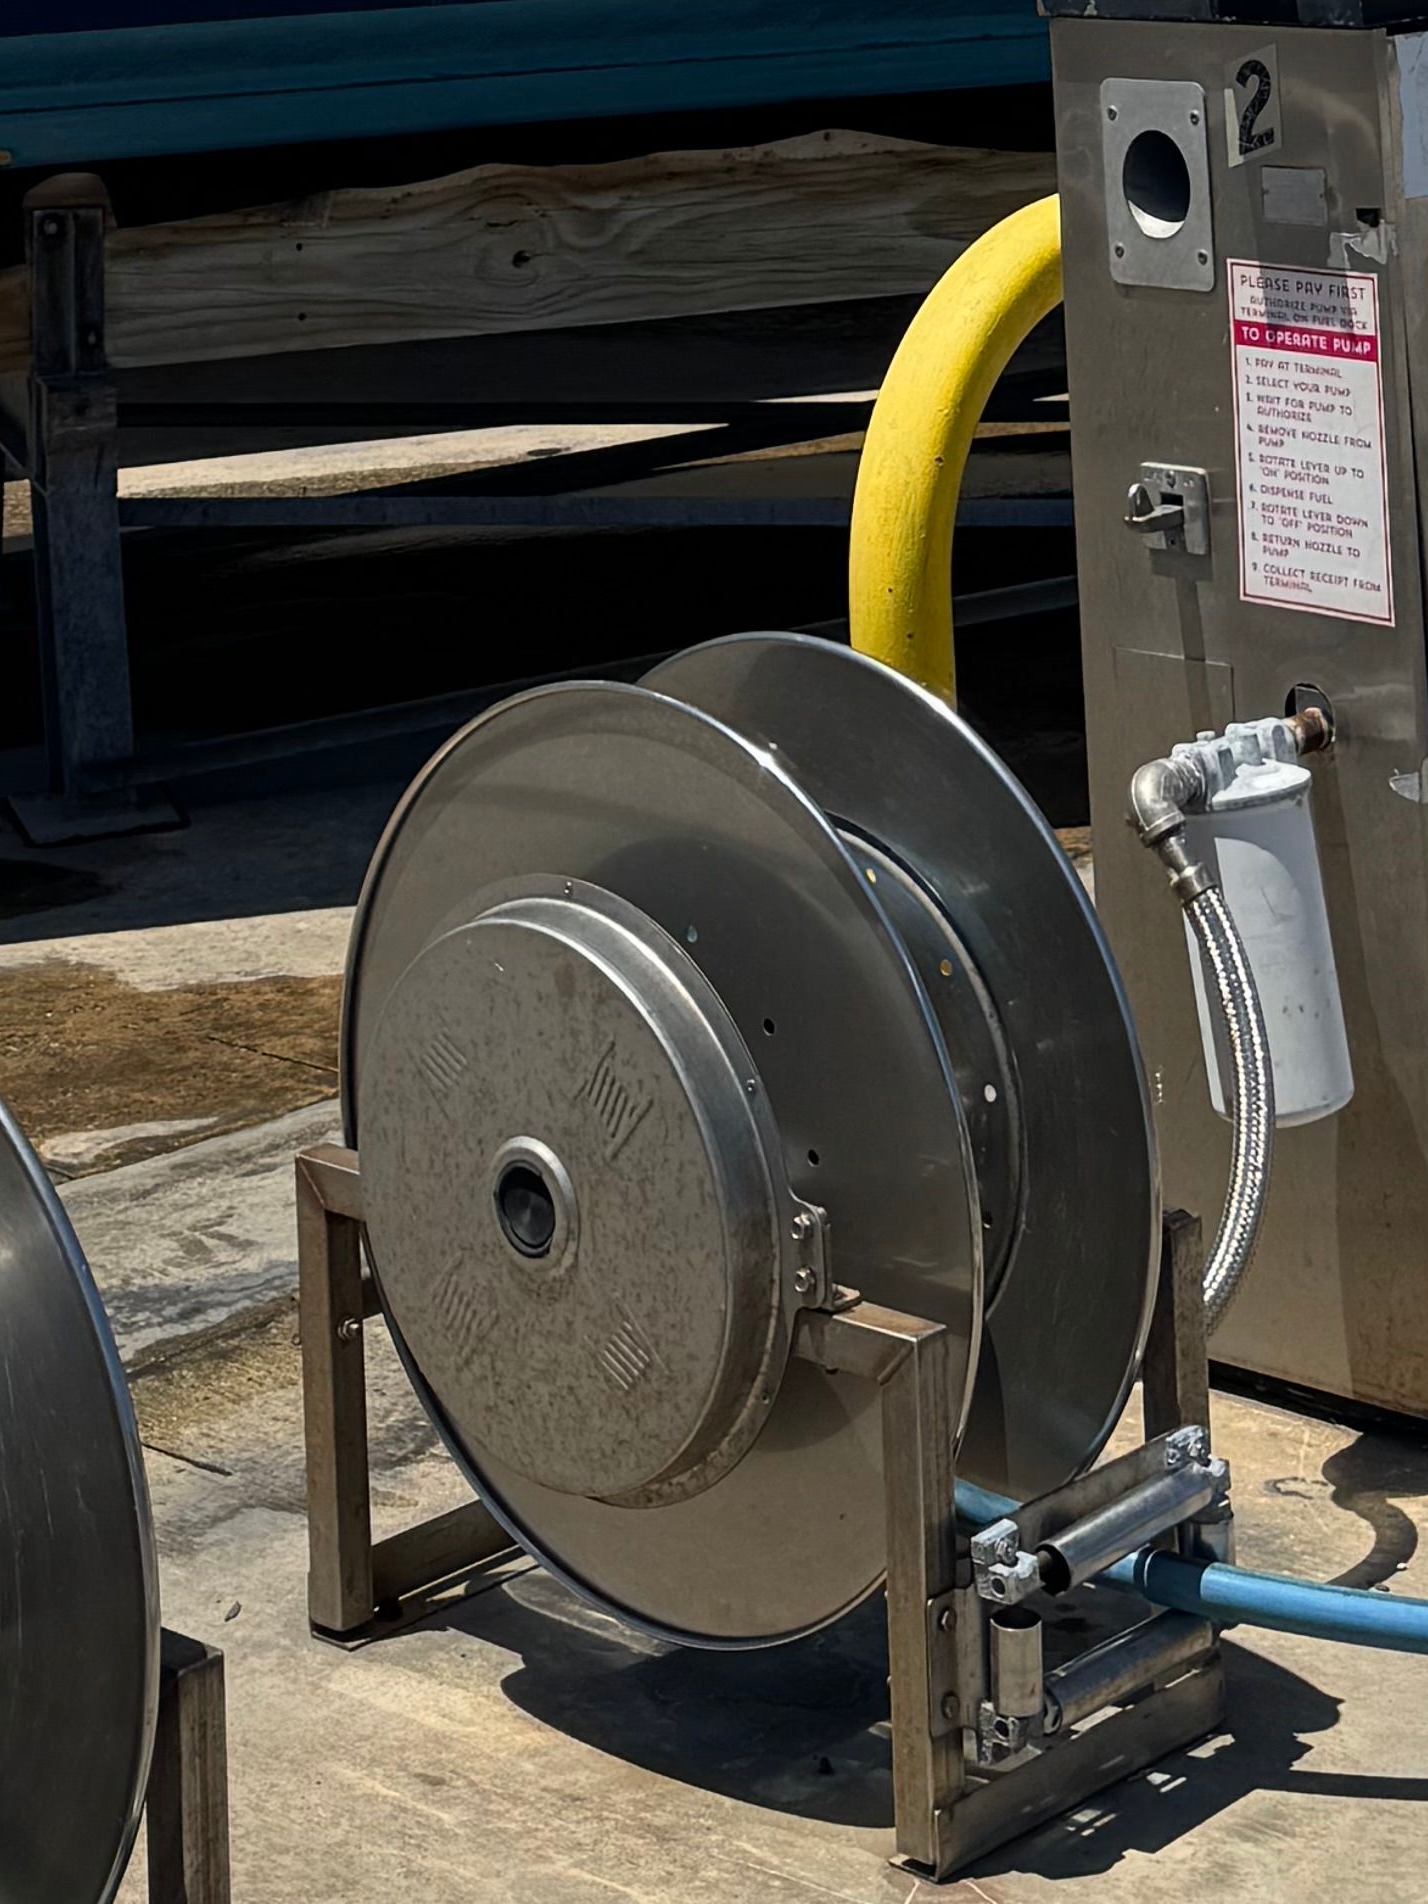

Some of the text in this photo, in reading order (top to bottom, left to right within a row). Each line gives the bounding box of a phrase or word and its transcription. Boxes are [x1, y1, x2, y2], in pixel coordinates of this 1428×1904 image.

[1236, 59, 1274, 155] 2
[1240, 274, 1365, 300] PLEASE PAY FIRST
[1250, 296, 1306, 312] AUTHORIZE
[1310, 303, 1337, 313] PUMP
[1241, 307, 1290, 322] TERMINAL
[1312, 314, 1337, 327] FUEL
[1340, 319, 1368, 330] DOCK
[1241, 326, 1371, 355] TO OPERATE PUMP
[1255, 358, 1273, 368] PAY
[1278, 361, 1289, 370] AT
[1256, 376, 1289, 388] SELECT
[1293, 381, 1320, 393] YOUR
[1324, 385, 1351, 397] PUMP
[1257, 406, 1312, 423] AUTHORIZE
[1285, 398, 1304, 409] FOR
[1308, 401, 1335, 413] PUMP
[1339, 405, 1352, 416] TO
[1258, 424, 1296, 439] REMOVE
[1301, 430, 1339, 444] NOZZLE
[1344, 436, 1372, 449] FROM
[1258, 436, 1285, 448] PUMP
[1259, 454, 1296, 468] ROTATE
[1301, 460, 1330, 474] LEVER
[1334, 466, 1348, 476] UP
[1351, 468, 1364, 479] TO
[1284, 470, 1329, 485] POSITION
[1260, 485, 1304, 501] DISPENSE
[1309, 493, 1333, 505] FUEL
[1261, 503, 1298, 518] ROTATE
[1302, 509, 1332, 522] LEVER
[1336, 515, 1369, 528] DOWN
[1262, 515, 1274, 525] TO
[1307, 522, 1353, 539] POSITION
[1262, 533, 1300, 548] RETURN
[1304, 539, 1343, 554] NOZZLE
[1347, 547, 1360, 558] TO
[1263, 545, 1289, 558] PUMP
[1263, 563, 1381, 592] COLLECT RECEIPT FROM
